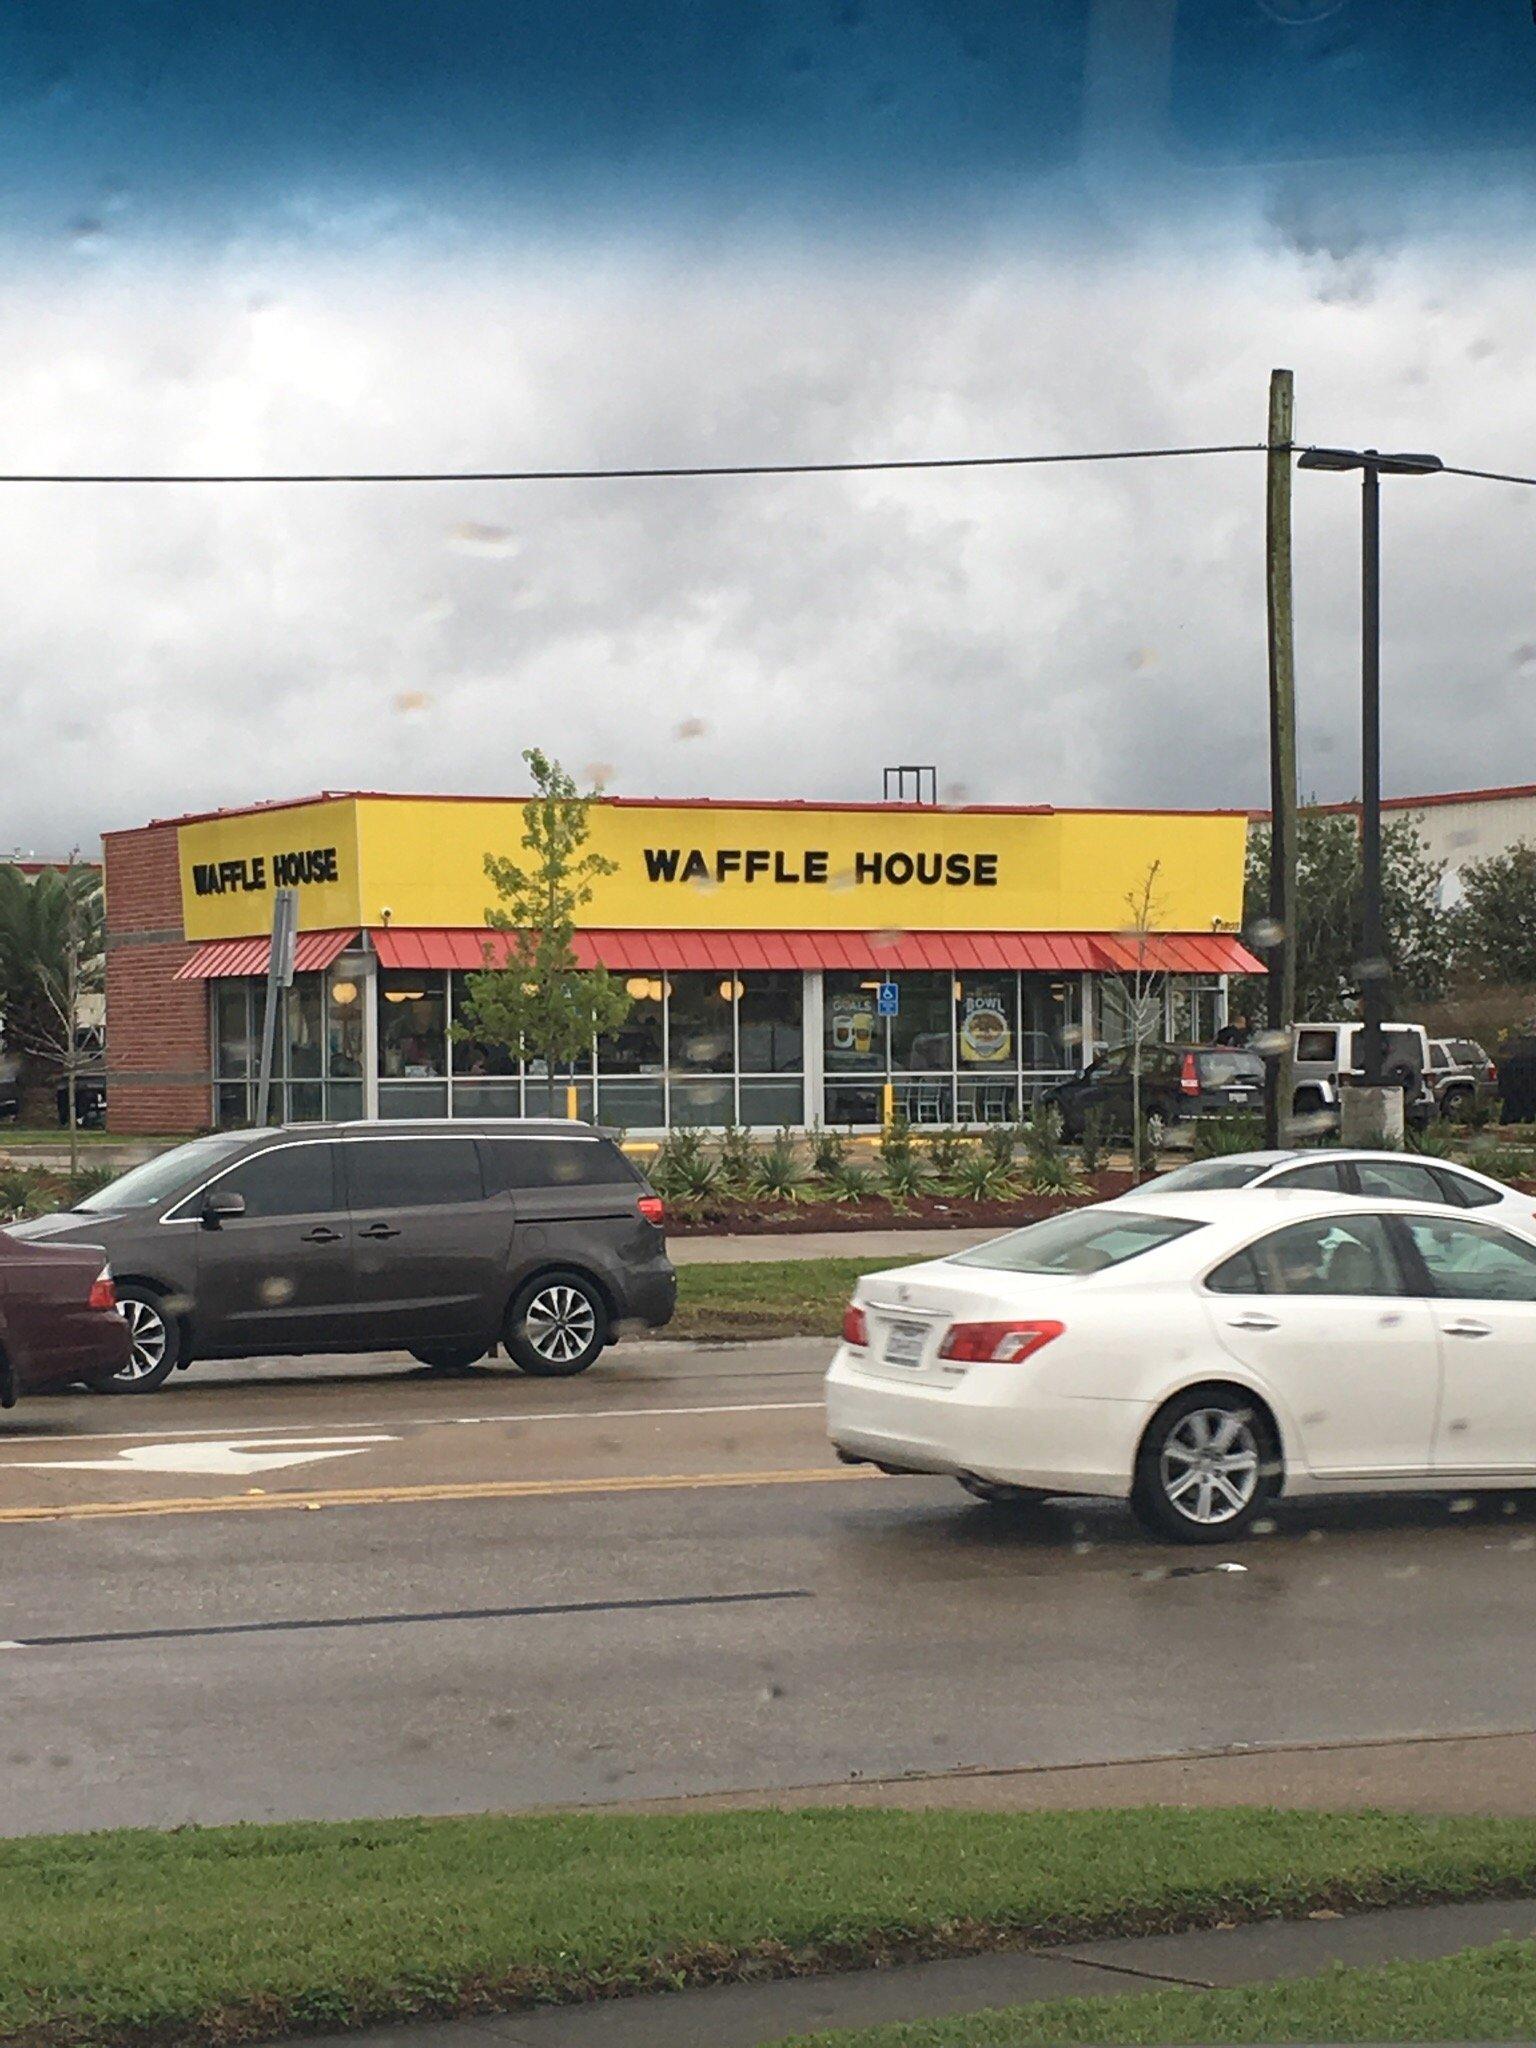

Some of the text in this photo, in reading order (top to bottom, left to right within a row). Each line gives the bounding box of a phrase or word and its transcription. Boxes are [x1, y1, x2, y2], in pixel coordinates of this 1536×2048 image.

[192, 847, 338, 896] WAFFLE HOUSE
[643, 849, 998, 887] WAFFLE HOUSE
